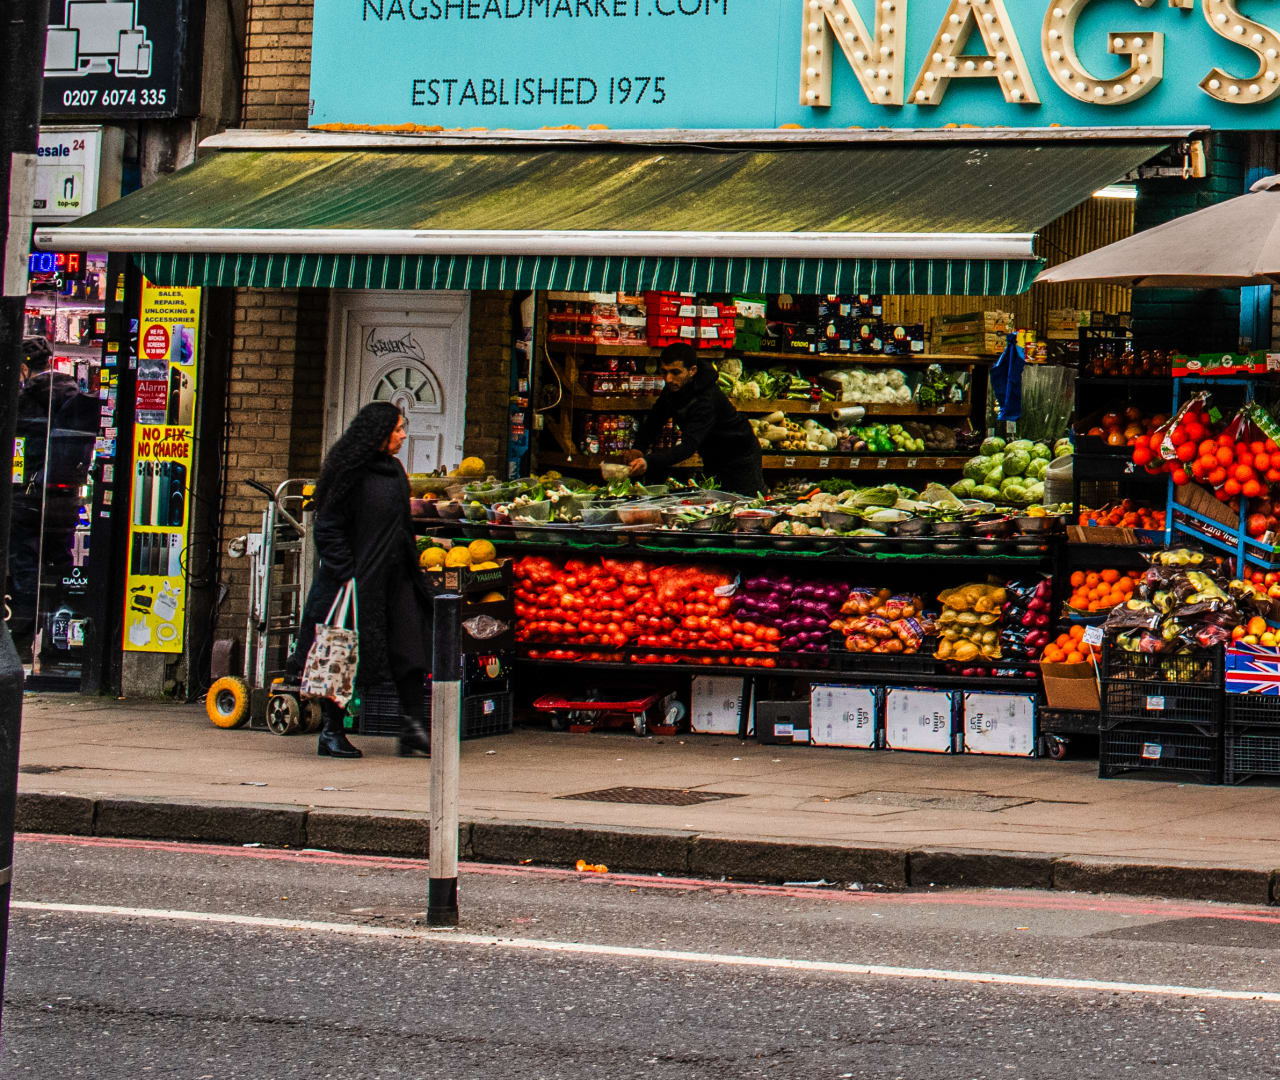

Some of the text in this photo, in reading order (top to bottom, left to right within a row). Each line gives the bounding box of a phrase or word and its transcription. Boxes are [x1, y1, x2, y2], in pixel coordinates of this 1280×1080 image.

[63, 89, 166, 106] 0207 6074 335
[411, 76, 666, 108] ESTABLISHED 1975
[73, 139, 85, 151] 24
[137, 381, 167, 392] Alarm
[142, 428, 185, 442] NO FIX
[137, 441, 189, 458] NO CHARGE
